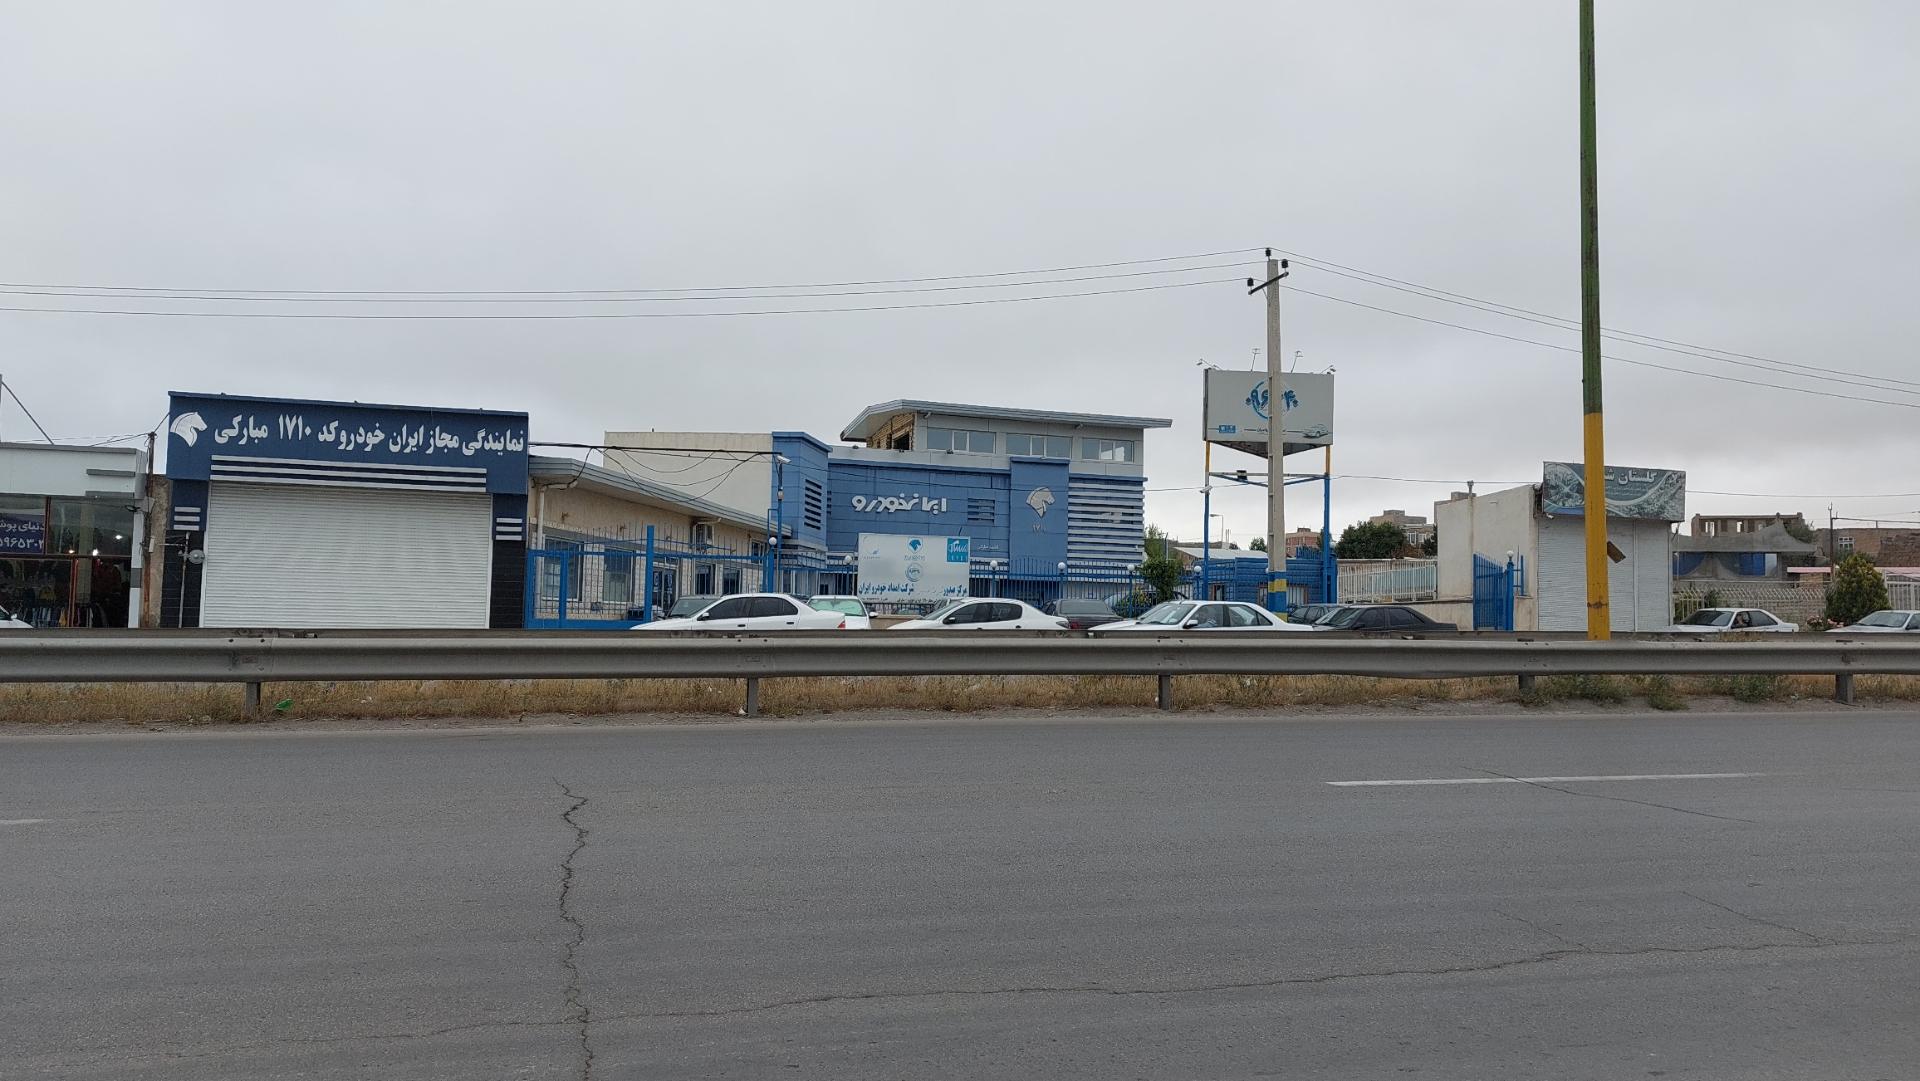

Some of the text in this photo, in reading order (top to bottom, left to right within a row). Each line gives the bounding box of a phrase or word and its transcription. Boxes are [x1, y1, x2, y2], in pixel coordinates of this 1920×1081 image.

[214, 414, 524, 456] نمایندگی مجاز ایران خودرو کد ۱۷۱۰ مبارکی
